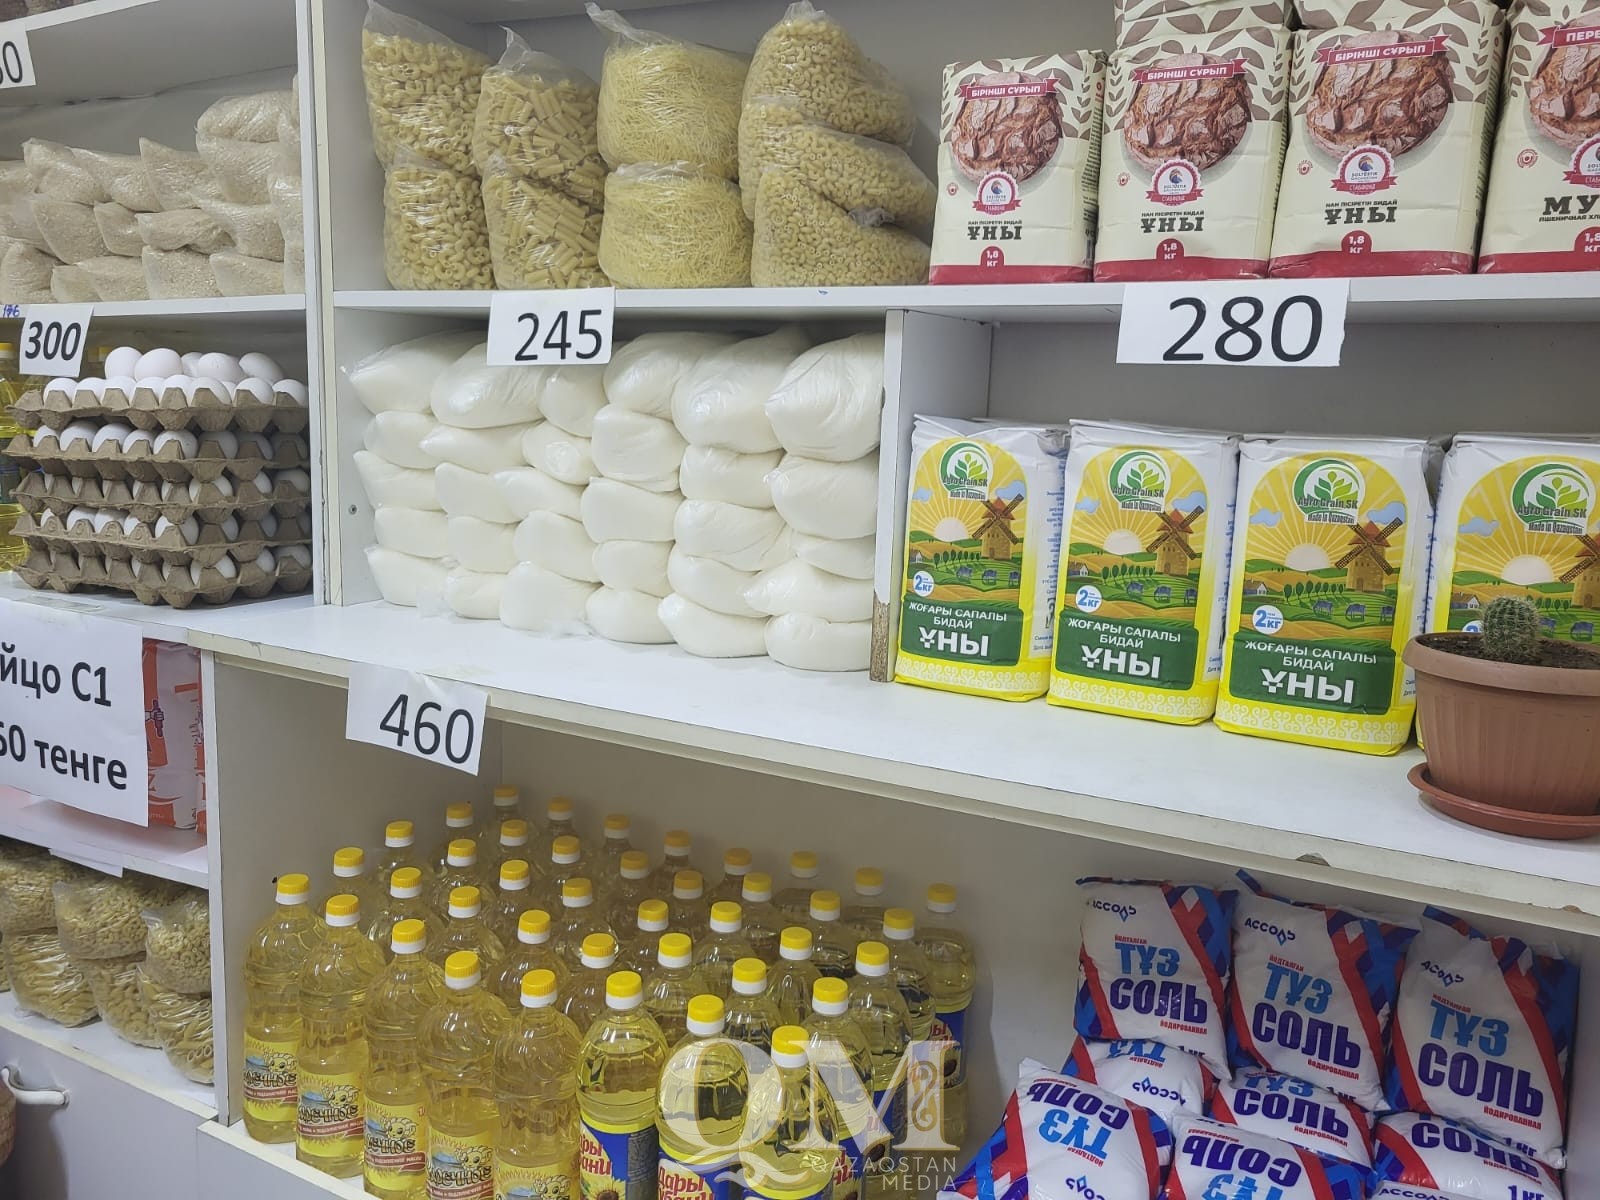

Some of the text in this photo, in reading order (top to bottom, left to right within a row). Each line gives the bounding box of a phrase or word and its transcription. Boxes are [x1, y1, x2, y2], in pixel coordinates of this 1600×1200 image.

[0, 41, 23, 84] 0
[1335, 49, 1380, 62] БІРІНШІ
[972, 86, 1005, 97] БІРІНШІ
[1147, 70, 1187, 80] БІРІНШІ
[967, 226, 1022, 240] ҰНЫ
[1141, 217, 1204, 233] ҰНЫ
[1324, 207, 1397, 225] ҰНЫ
[986, 250, 999, 259] 1,8
[1163, 243, 1177, 252] 1,8
[1349, 236, 1365, 245] 1,8
[25, 321, 81, 361] 300
[514, 309, 602, 361] 245
[1162, 295, 1323, 363] 280
[1320, 498, 1343, 509] Grain
[1344, 500, 1358, 509] SK
[1543, 507, 1571, 518] Grain
[1573, 507, 1587, 518] SK
[909, 601, 1007, 622] ЖОҒАРЫ САПАЛЫ
[933, 616, 973, 629] БИДАЙ
[918, 626, 989, 657] ҰНЫ
[1067, 618, 1181, 642] ЖОҒАРЫ САПАЛЫ
[1099, 634, 1144, 649] БИДАЙ
[1081, 645, 1161, 679] ҰНЫ
[1245, 640, 1377, 664] ЖОҒАРЫ САПАЛЫ
[1282, 656, 1334, 672] БИДАЙ
[1261, 668, 1354, 704] ҰНЫ
[380, 694, 474, 764] 460
[34, 739, 127, 790] тенге
[1114, 942, 1180, 977] ТҰЗ
[1110, 977, 1207, 1024] СОЛЬ
[1264, 962, 1333, 1014] ТҰЗ
[1252, 1002, 1361, 1069] СОЛЬ
[1430, 998, 1509, 1057] ТҰЗ
[1418, 1042, 1544, 1118] СОЛЬ
[1027, 1083, 1130, 1129] СОЛЬ
[1233, 1089, 1349, 1138] СОЛЬ
[1039, 1109, 1112, 1160] ТҰЗ
[1411, 1122, 1539, 1178] СОЛЬ
[1182, 1135, 1302, 1187] СОЛЬ
